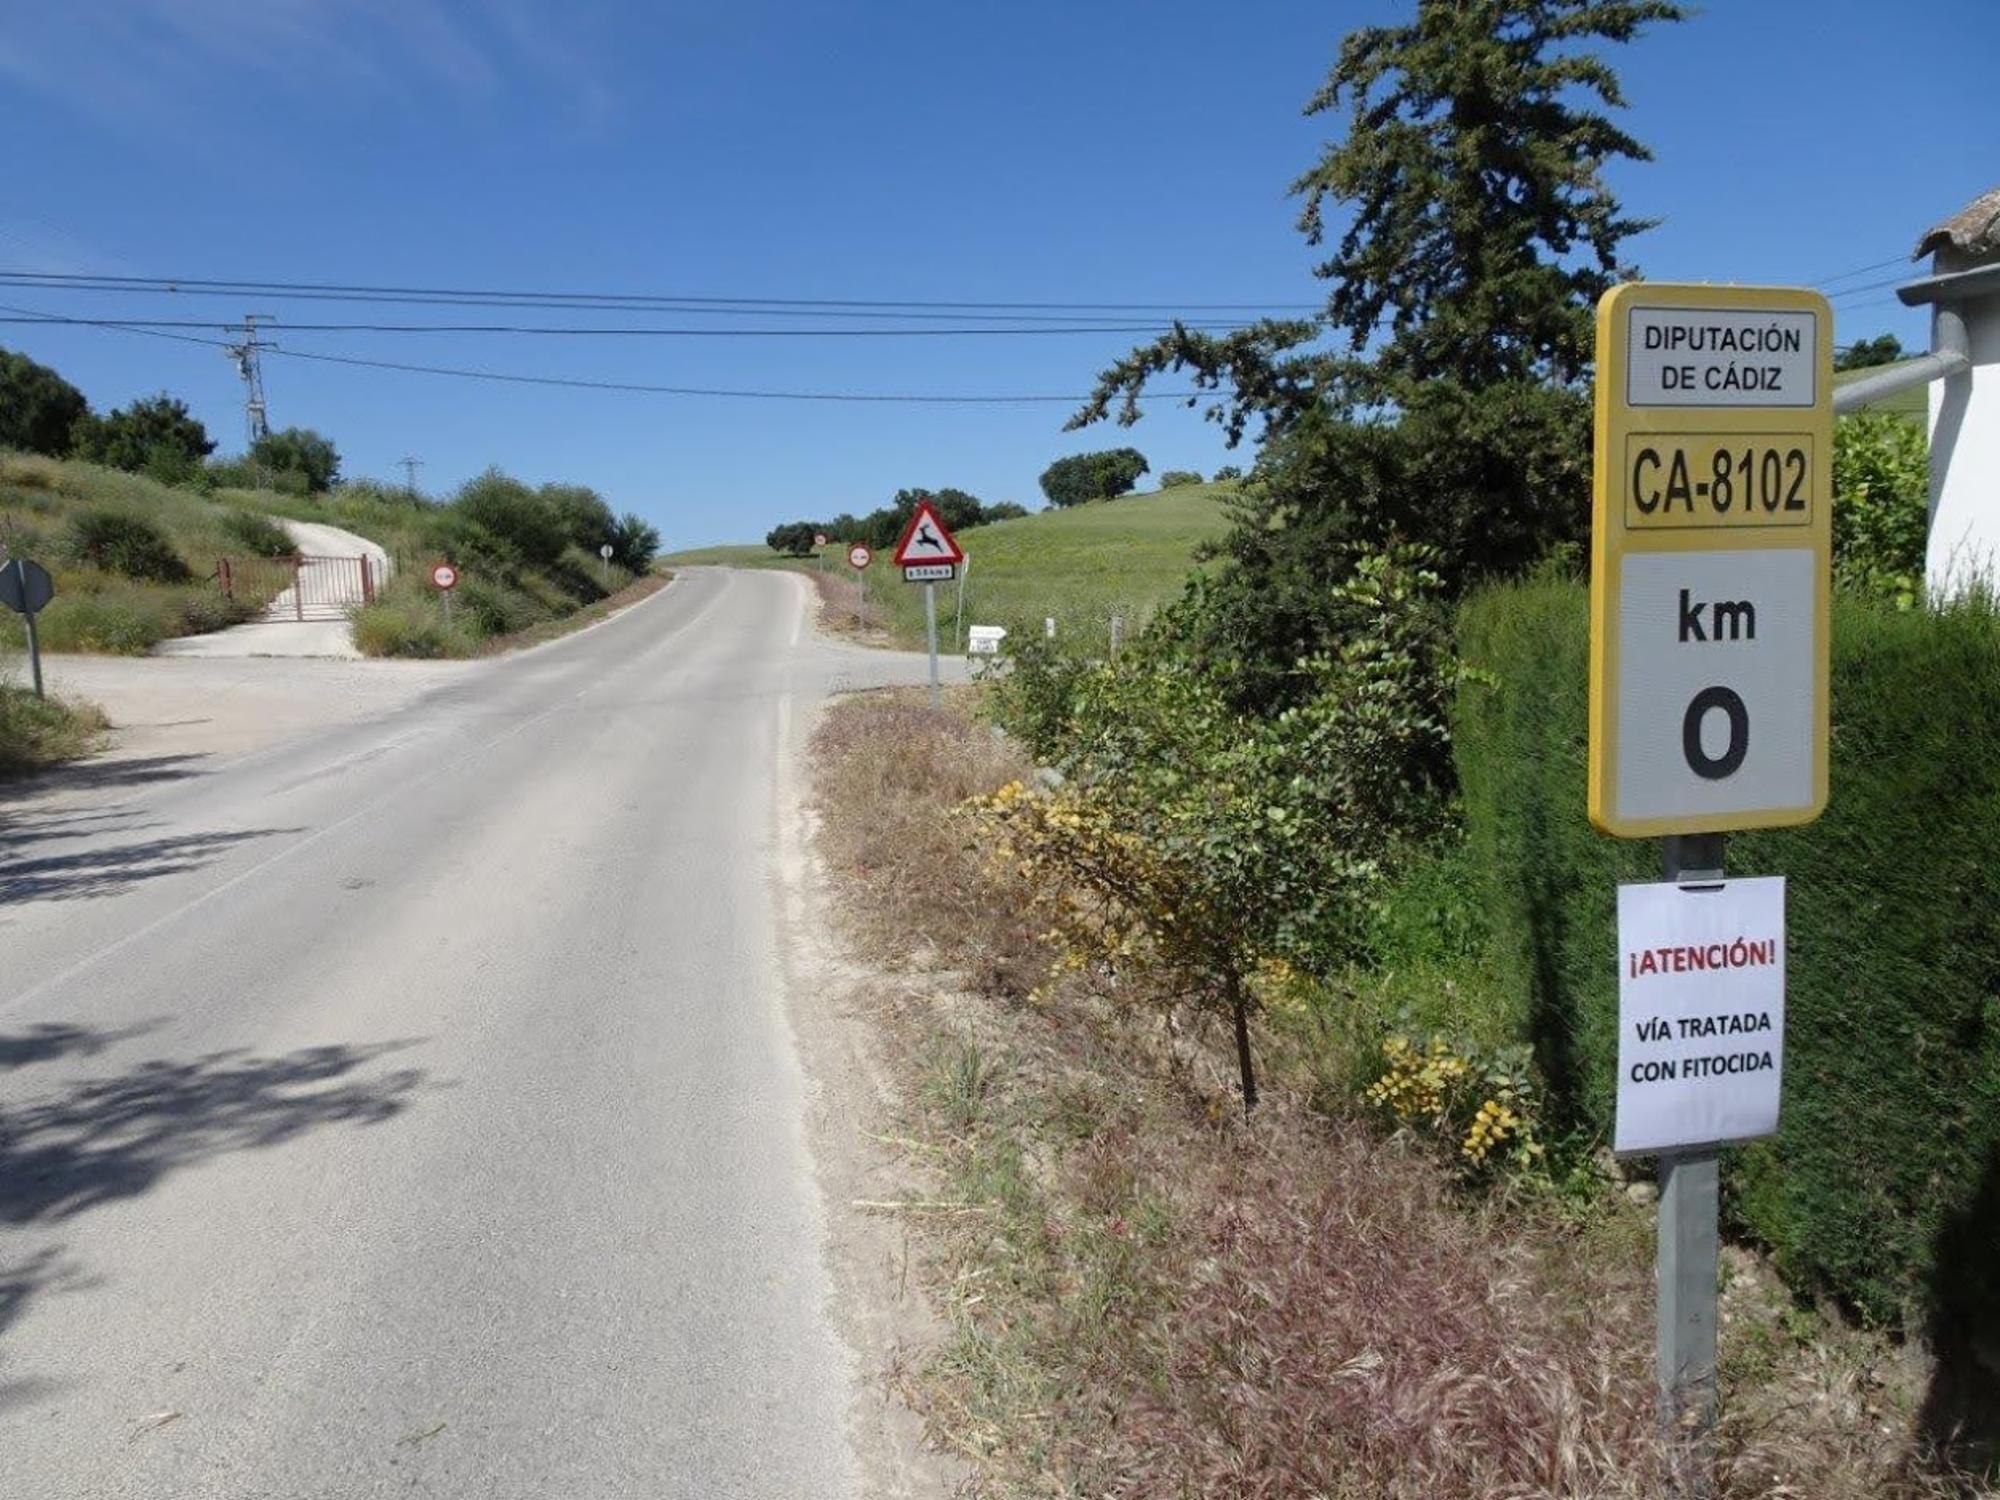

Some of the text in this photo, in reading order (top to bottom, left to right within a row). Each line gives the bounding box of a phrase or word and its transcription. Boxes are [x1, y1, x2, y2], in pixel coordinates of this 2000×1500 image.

[1645, 323, 1801, 353] DIPUTACIÓN
[1661, 361, 1782, 391] DE CÁDIZ
[1632, 447, 1806, 515] CA-8102
[1678, 588, 1756, 643] km
[1682, 685, 1749, 781] 0
[1630, 936, 1776, 979] ¡ATENCIÓN!
[1635, 1011, 1772, 1043] VÍA TRATADA
[1630, 1050, 1774, 1084] CON FITOCIDA
